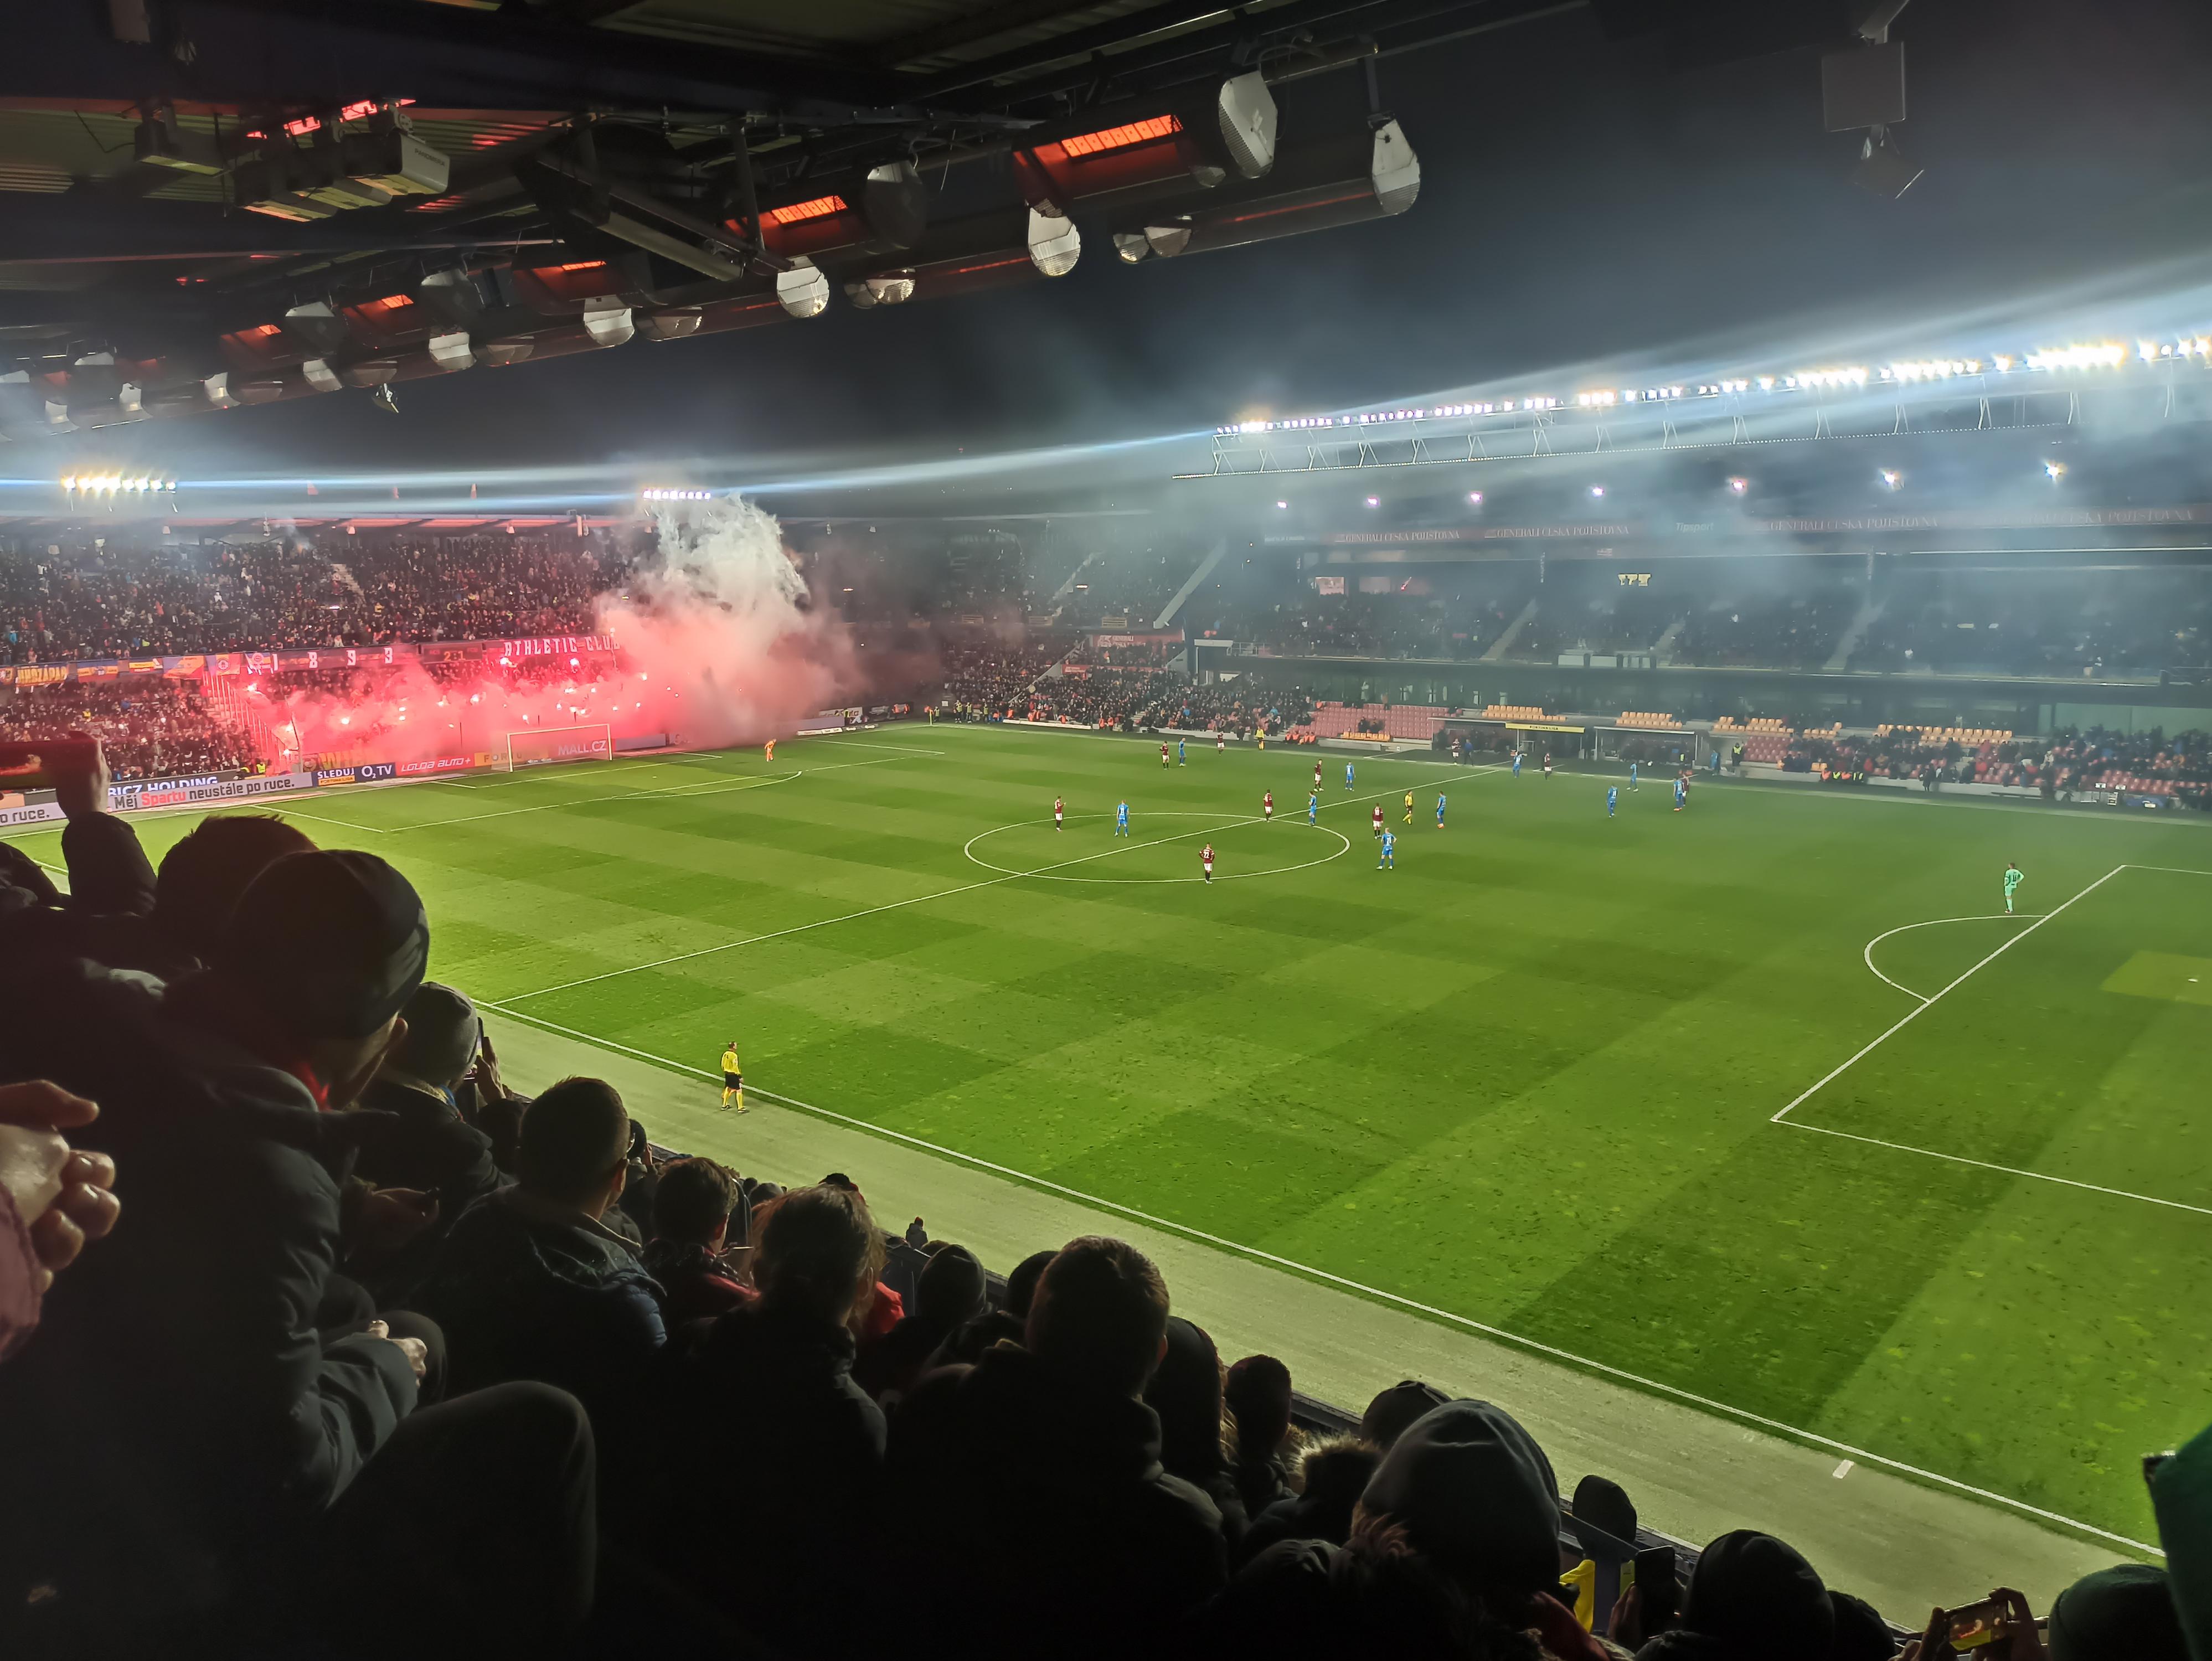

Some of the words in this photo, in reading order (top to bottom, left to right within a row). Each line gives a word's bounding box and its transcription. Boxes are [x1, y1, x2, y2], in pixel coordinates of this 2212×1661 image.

[503, 637, 578, 657] ATHLETIC
[558, 740, 607, 756] MALL.CZ
[317, 767, 355, 780] SLEDUJ
[376, 764, 393, 776] TV
[147, 776, 218, 792] HOLDING
[114, 794, 137, 809] Měj
[141, 790, 187, 807] Spartu
[189, 783, 243, 799] neustále
[246, 782, 261, 795] po
[264, 778, 295, 791] ruce.
[12, 809, 50, 822] ruce.
